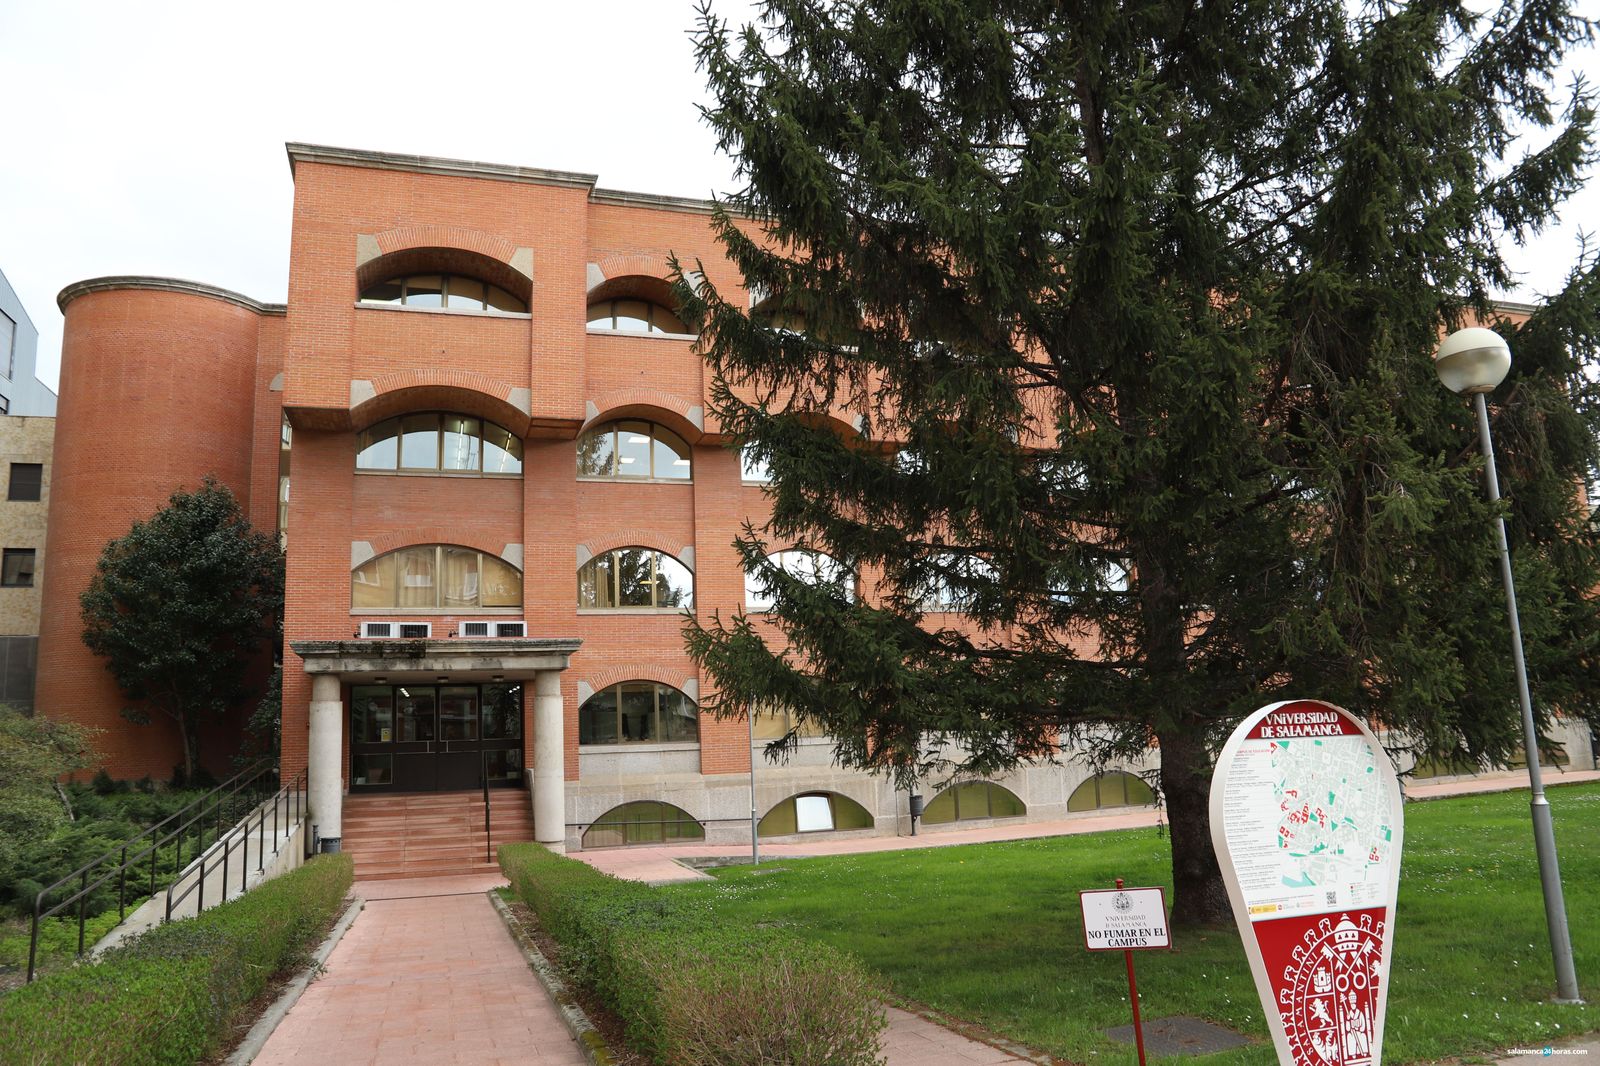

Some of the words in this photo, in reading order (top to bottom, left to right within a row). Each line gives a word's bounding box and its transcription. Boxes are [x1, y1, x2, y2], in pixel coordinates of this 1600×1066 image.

[1261, 726, 1275, 738] DE
[1276, 724, 1343, 738] SALAMANCA
[1088, 930, 1102, 939] NO
[1104, 929, 1137, 939] FUMAR
[1140, 928, 1152, 937] EN
[1154, 928, 1166, 937] EL
[1108, 938, 1148, 947] CAMPUS
